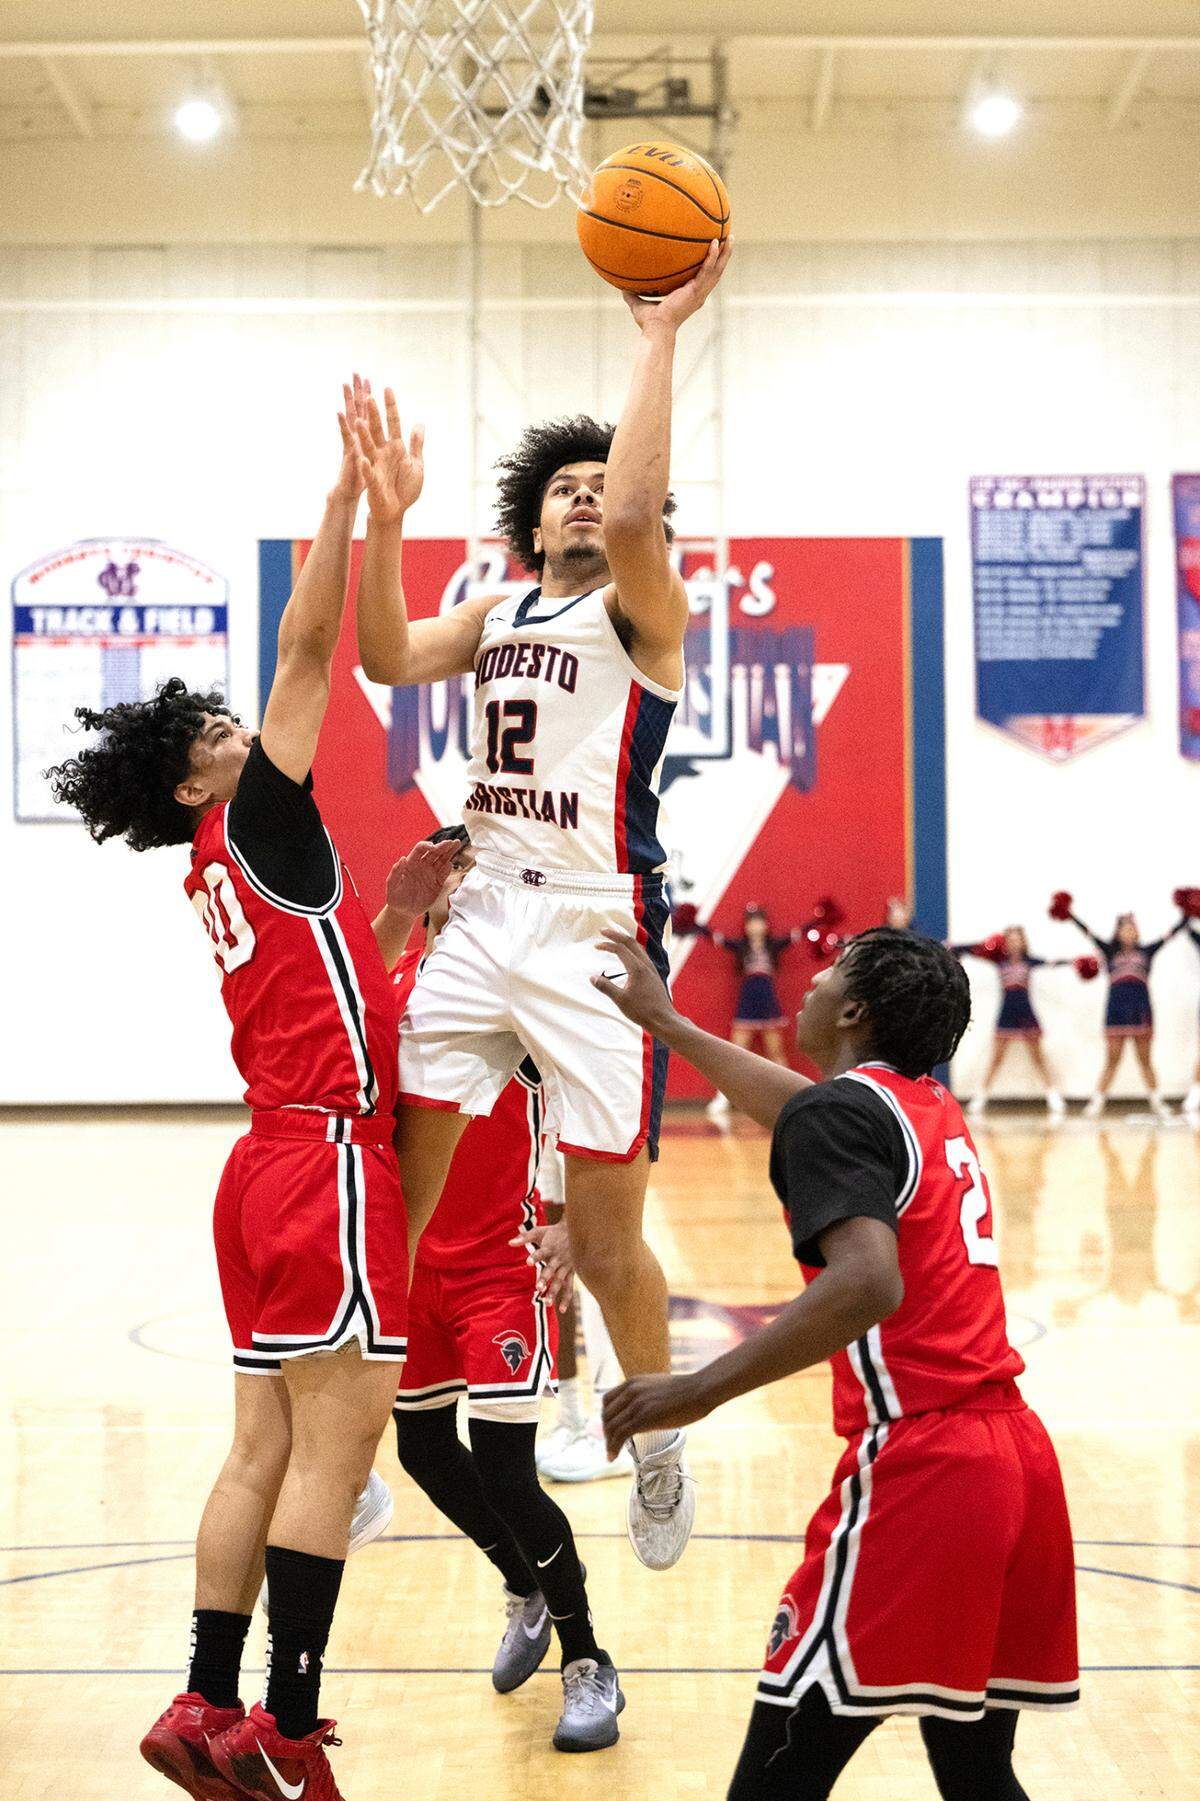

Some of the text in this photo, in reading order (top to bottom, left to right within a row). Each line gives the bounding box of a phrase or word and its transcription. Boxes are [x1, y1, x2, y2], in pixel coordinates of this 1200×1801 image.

[30, 608, 111, 635] TRACK
[144, 608, 214, 635] FIELD
[475, 643, 579, 694] ODESTO
[485, 699, 538, 776] 12
